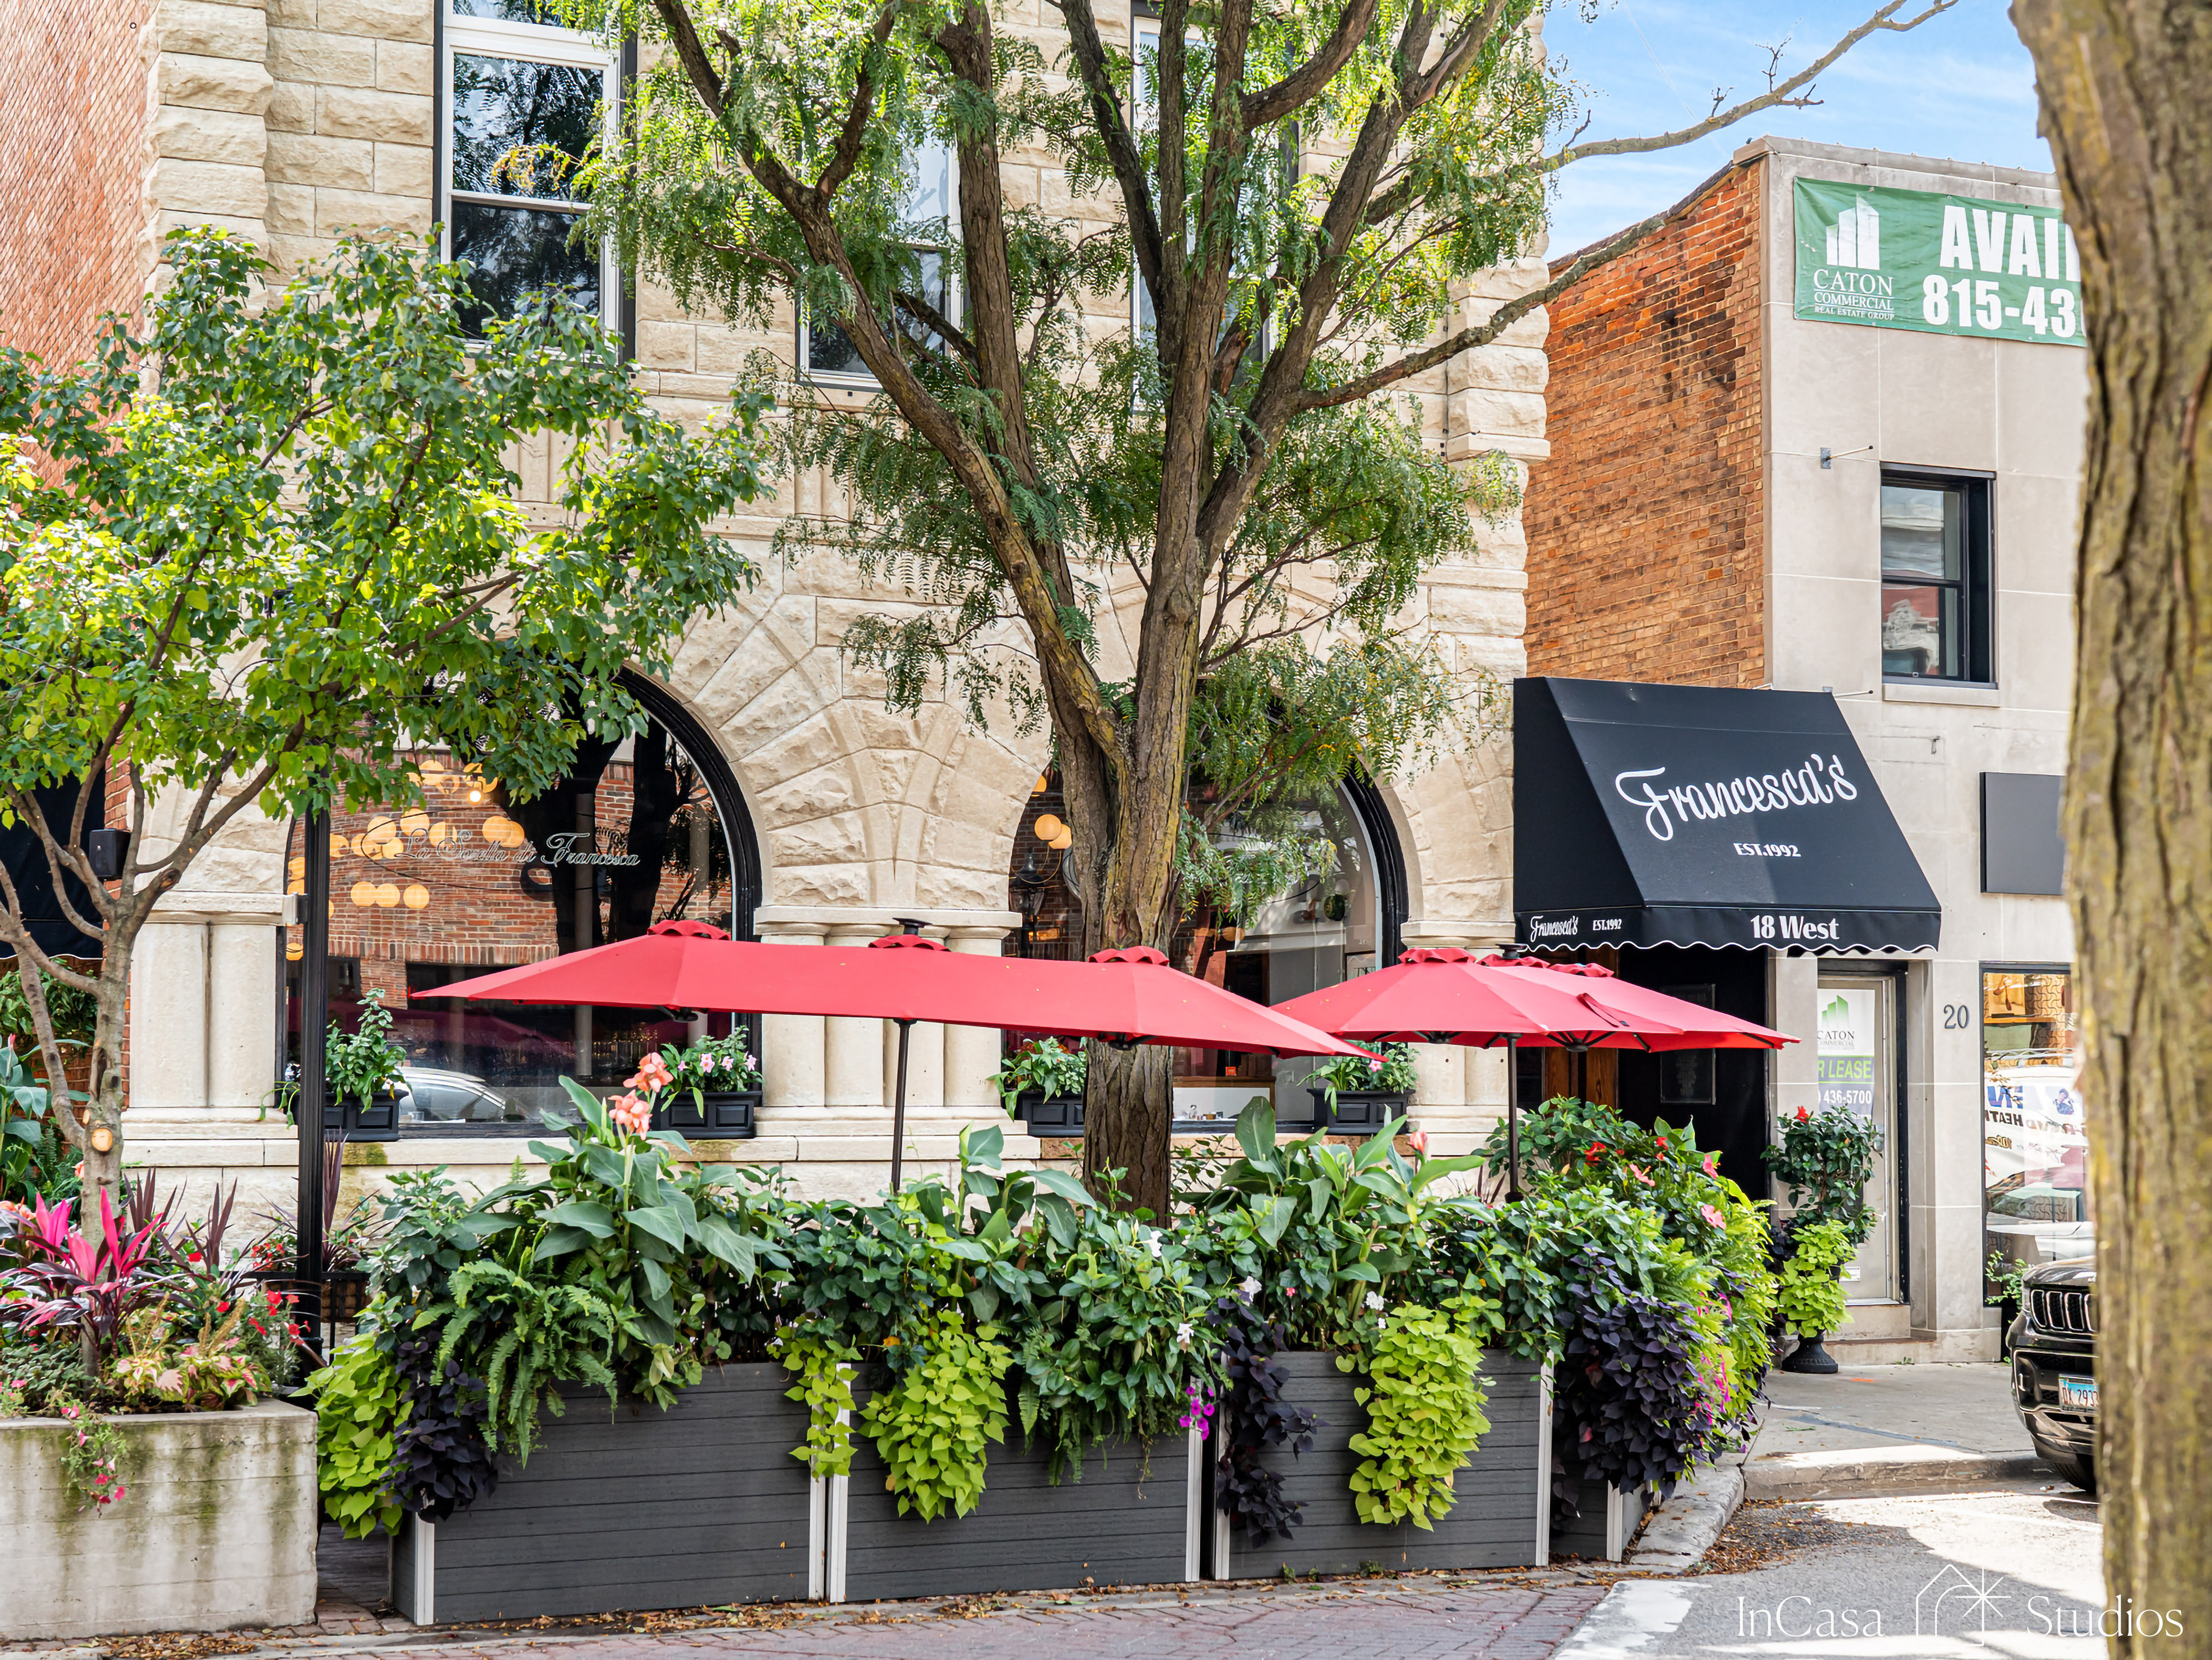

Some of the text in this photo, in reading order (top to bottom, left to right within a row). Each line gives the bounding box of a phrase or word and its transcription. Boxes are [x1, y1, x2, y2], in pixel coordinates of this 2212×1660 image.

[1814, 269, 1893, 296] CATON
[1814, 292, 1894, 310] COMMERCIAL
[1814, 305, 1894, 320] REAL ESTATE GROUP
[1923, 275, 2087, 337] 815-43
[1615, 753, 1858, 841] Francesca's
[394, 828, 641, 868] La Sorella di Francesca
[1733, 843, 1801, 858] EST.1992
[1530, 915, 1622, 942] Francesca's EST.1992
[1750, 915, 1840, 940] 18 West
[1943, 1004, 1970, 1029] 20
[1817, 1030, 1855, 1040] CATON
[1828, 1060, 1872, 1079] LEASE
[1823, 1089, 1871, 1104] 436-5700
